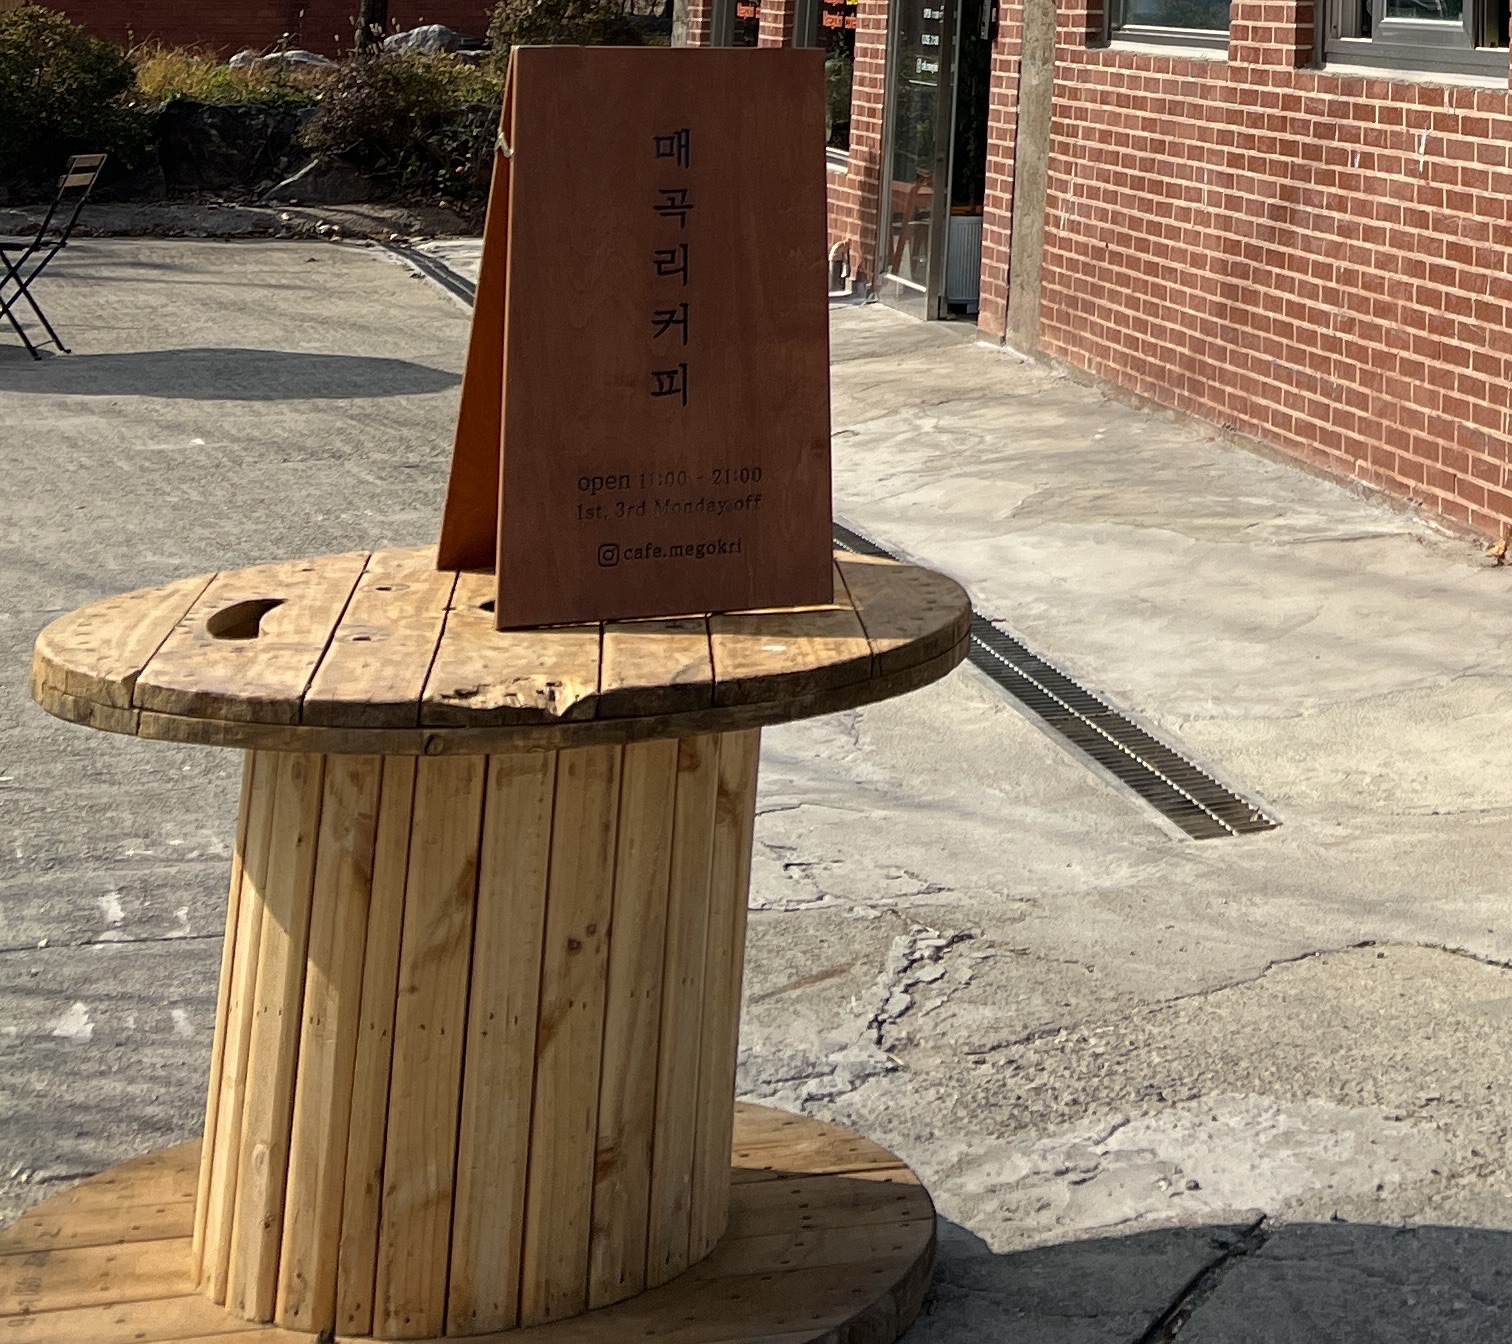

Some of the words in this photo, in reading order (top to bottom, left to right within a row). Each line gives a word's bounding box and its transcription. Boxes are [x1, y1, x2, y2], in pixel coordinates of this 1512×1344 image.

[577, 473, 631, 496] open
[639, 470, 688, 490] 11:00
[711, 467, 763, 486] 21:00
[576, 503, 609, 521] 1st,
[616, 500, 647, 518] 3rd
[654, 497, 728, 515] Monday
[734, 493, 763, 511] off
[623, 537, 743, 560] cafe.megokri
